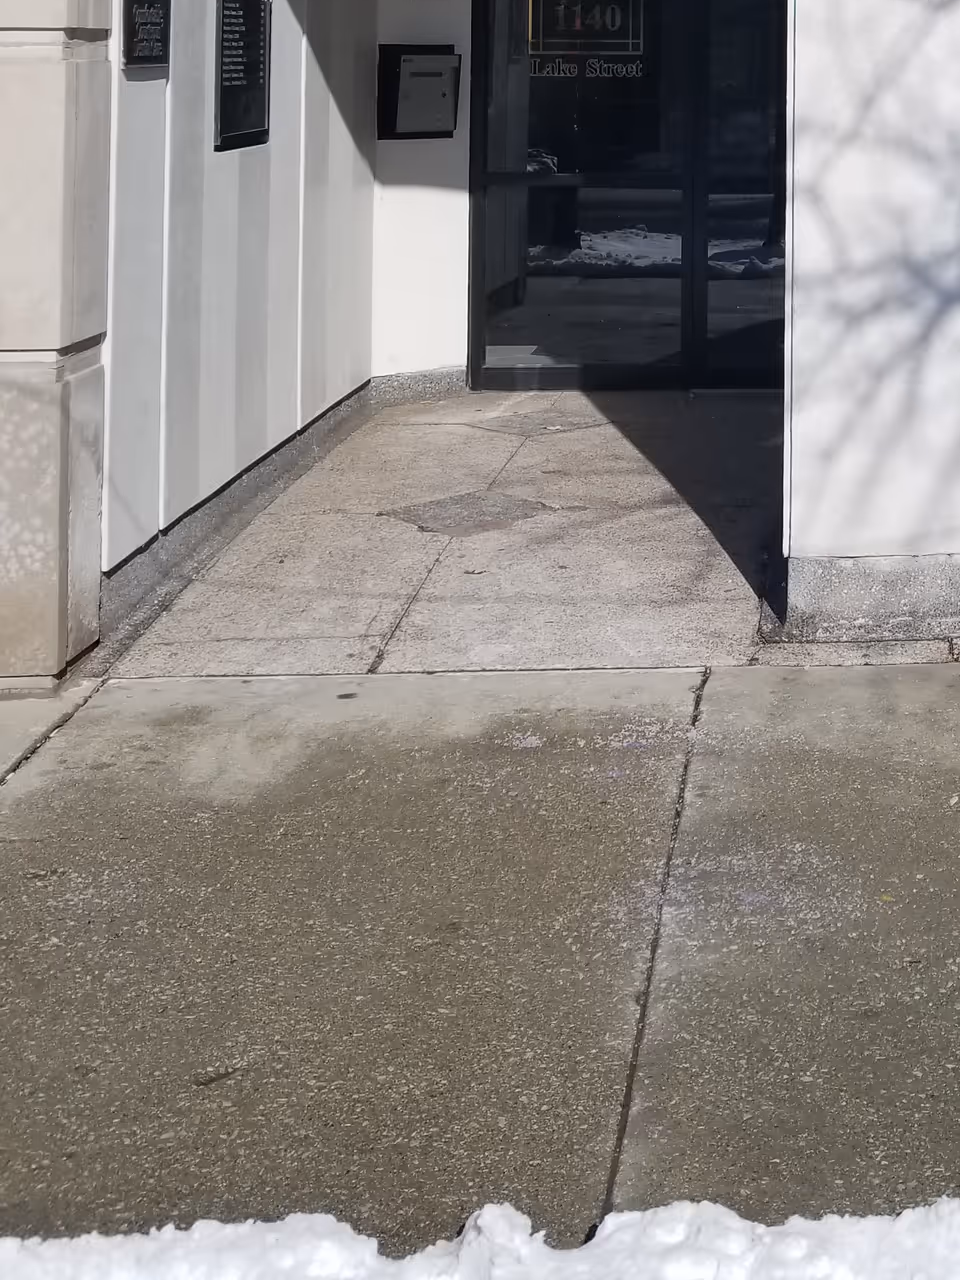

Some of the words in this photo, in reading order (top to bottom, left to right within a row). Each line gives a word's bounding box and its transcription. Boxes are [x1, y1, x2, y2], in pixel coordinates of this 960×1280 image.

[555, 2, 622, 31] 1140
[530, 58, 578, 77] Lake
[585, 58, 643, 77] Street
